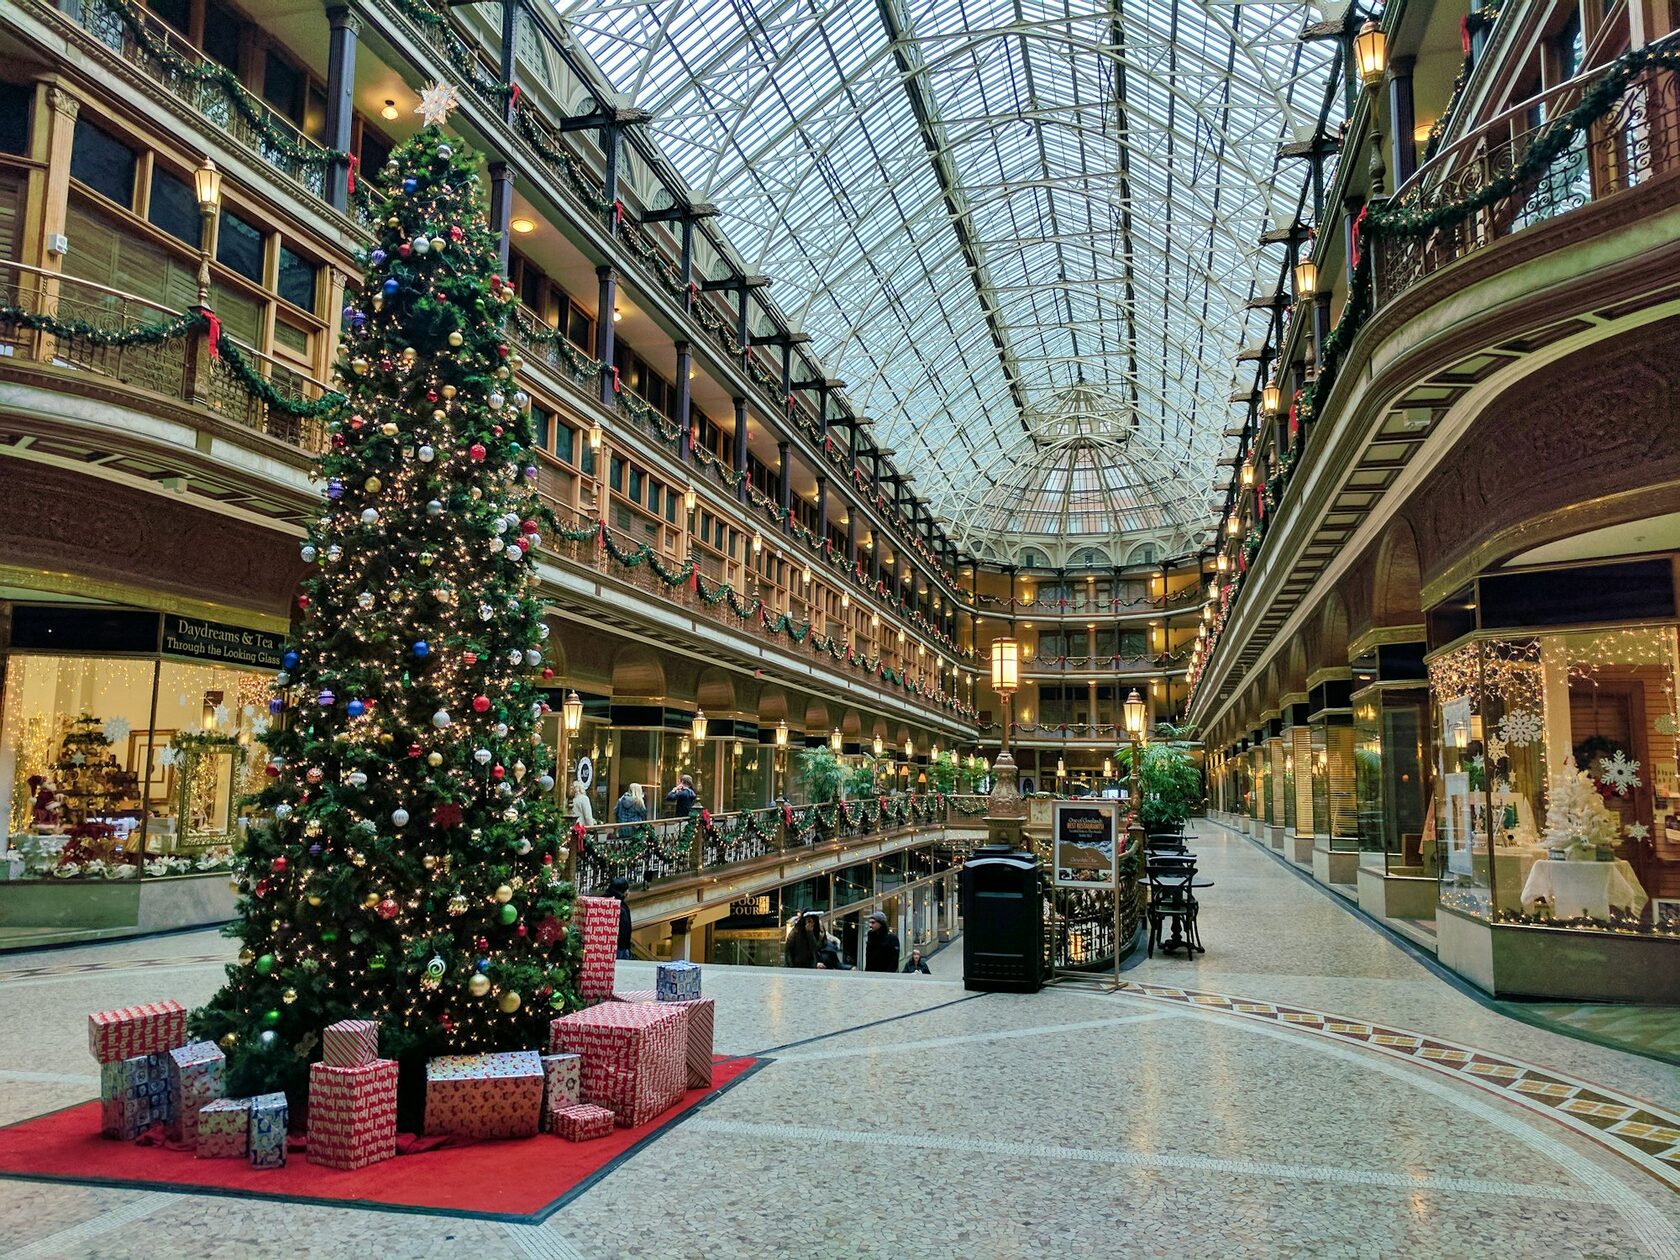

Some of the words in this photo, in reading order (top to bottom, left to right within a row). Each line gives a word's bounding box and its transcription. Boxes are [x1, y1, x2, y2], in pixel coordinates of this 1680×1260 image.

[179, 620, 240, 643] Daydreams
[242, 632, 253, 645] &
[256, 634, 273, 649] Tea
[167, 636, 205, 654] Through
[208, 644, 221, 655] the
[223, 646, 256, 663] Looking
[258, 652, 280, 665] Glass
